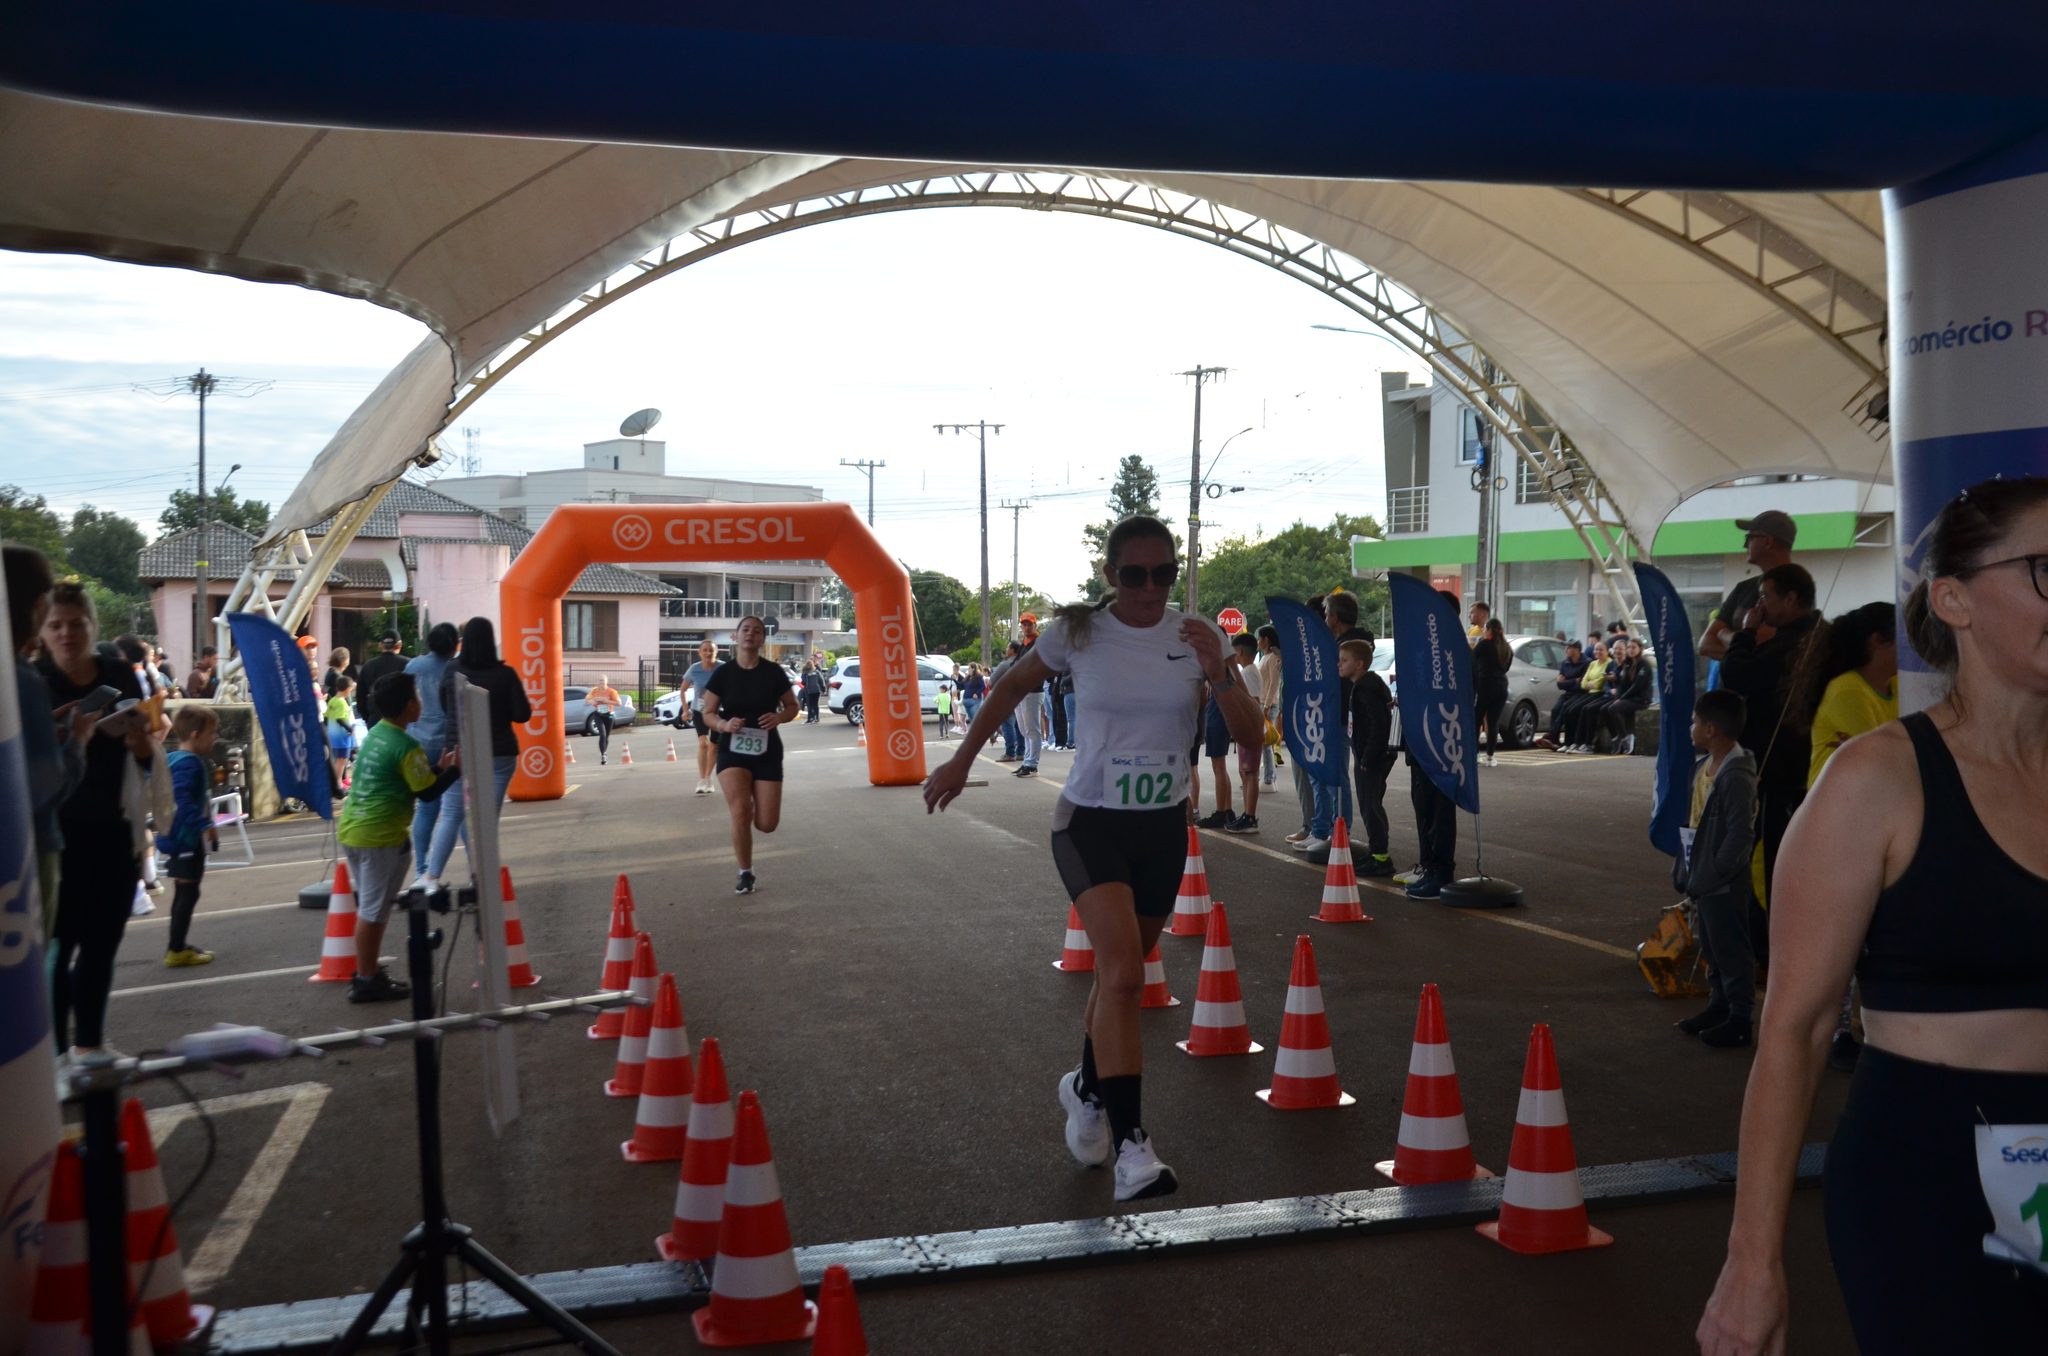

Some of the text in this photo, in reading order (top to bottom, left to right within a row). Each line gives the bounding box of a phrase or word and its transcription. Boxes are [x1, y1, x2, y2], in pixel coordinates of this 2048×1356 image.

[664, 517, 806, 545] CRESOL
[1219, 617, 1243, 626] PARE
[881, 604, 911, 720] CRESOL
[1296, 616, 1312, 682] Fecomércio
[1426, 613, 1443, 690] Fecomércio
[735, 735, 763, 753] 293
[1115, 771, 1174, 805] 102
